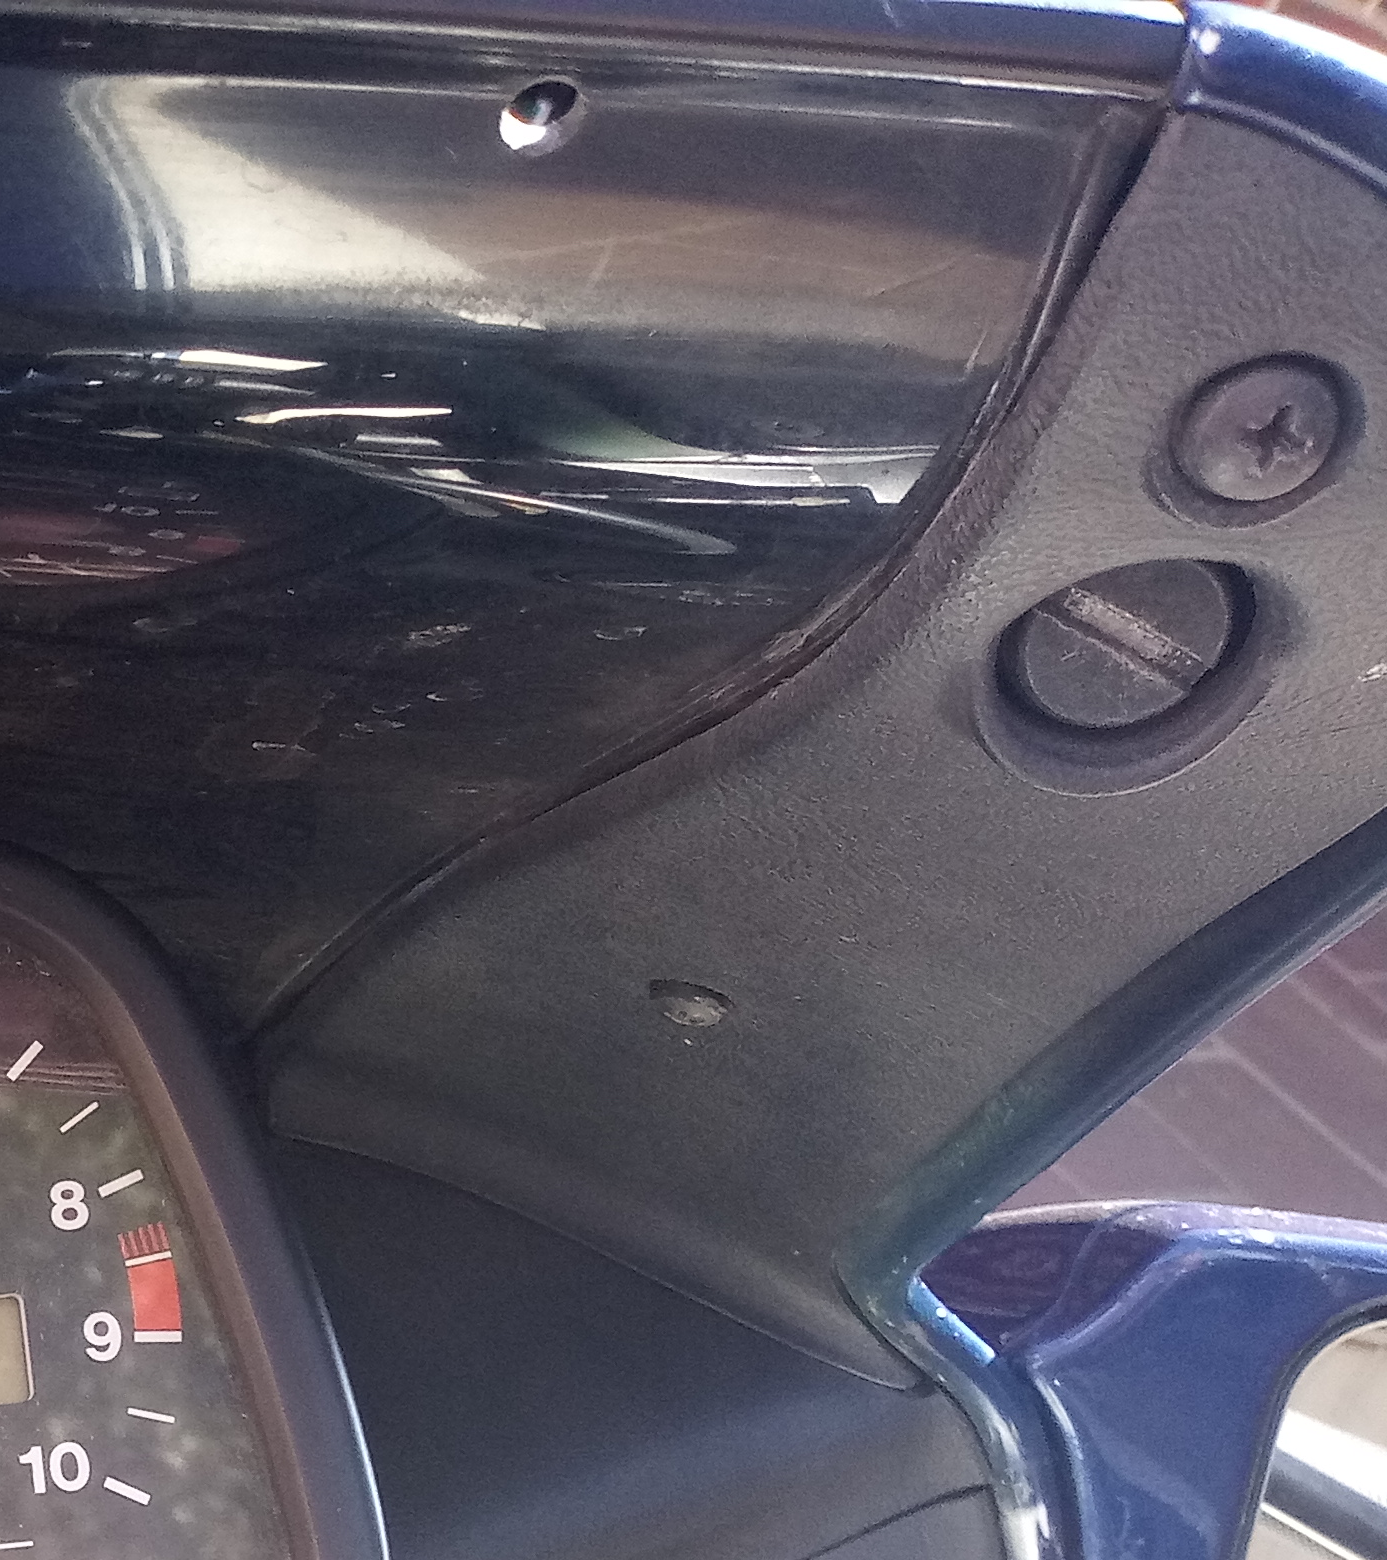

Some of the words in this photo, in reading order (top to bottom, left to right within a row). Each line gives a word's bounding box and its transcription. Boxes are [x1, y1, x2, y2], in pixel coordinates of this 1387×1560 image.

[49, 1180, 90, 1230] 8
[83, 1312, 123, 1362] 9
[18, 1441, 91, 1494] 10
